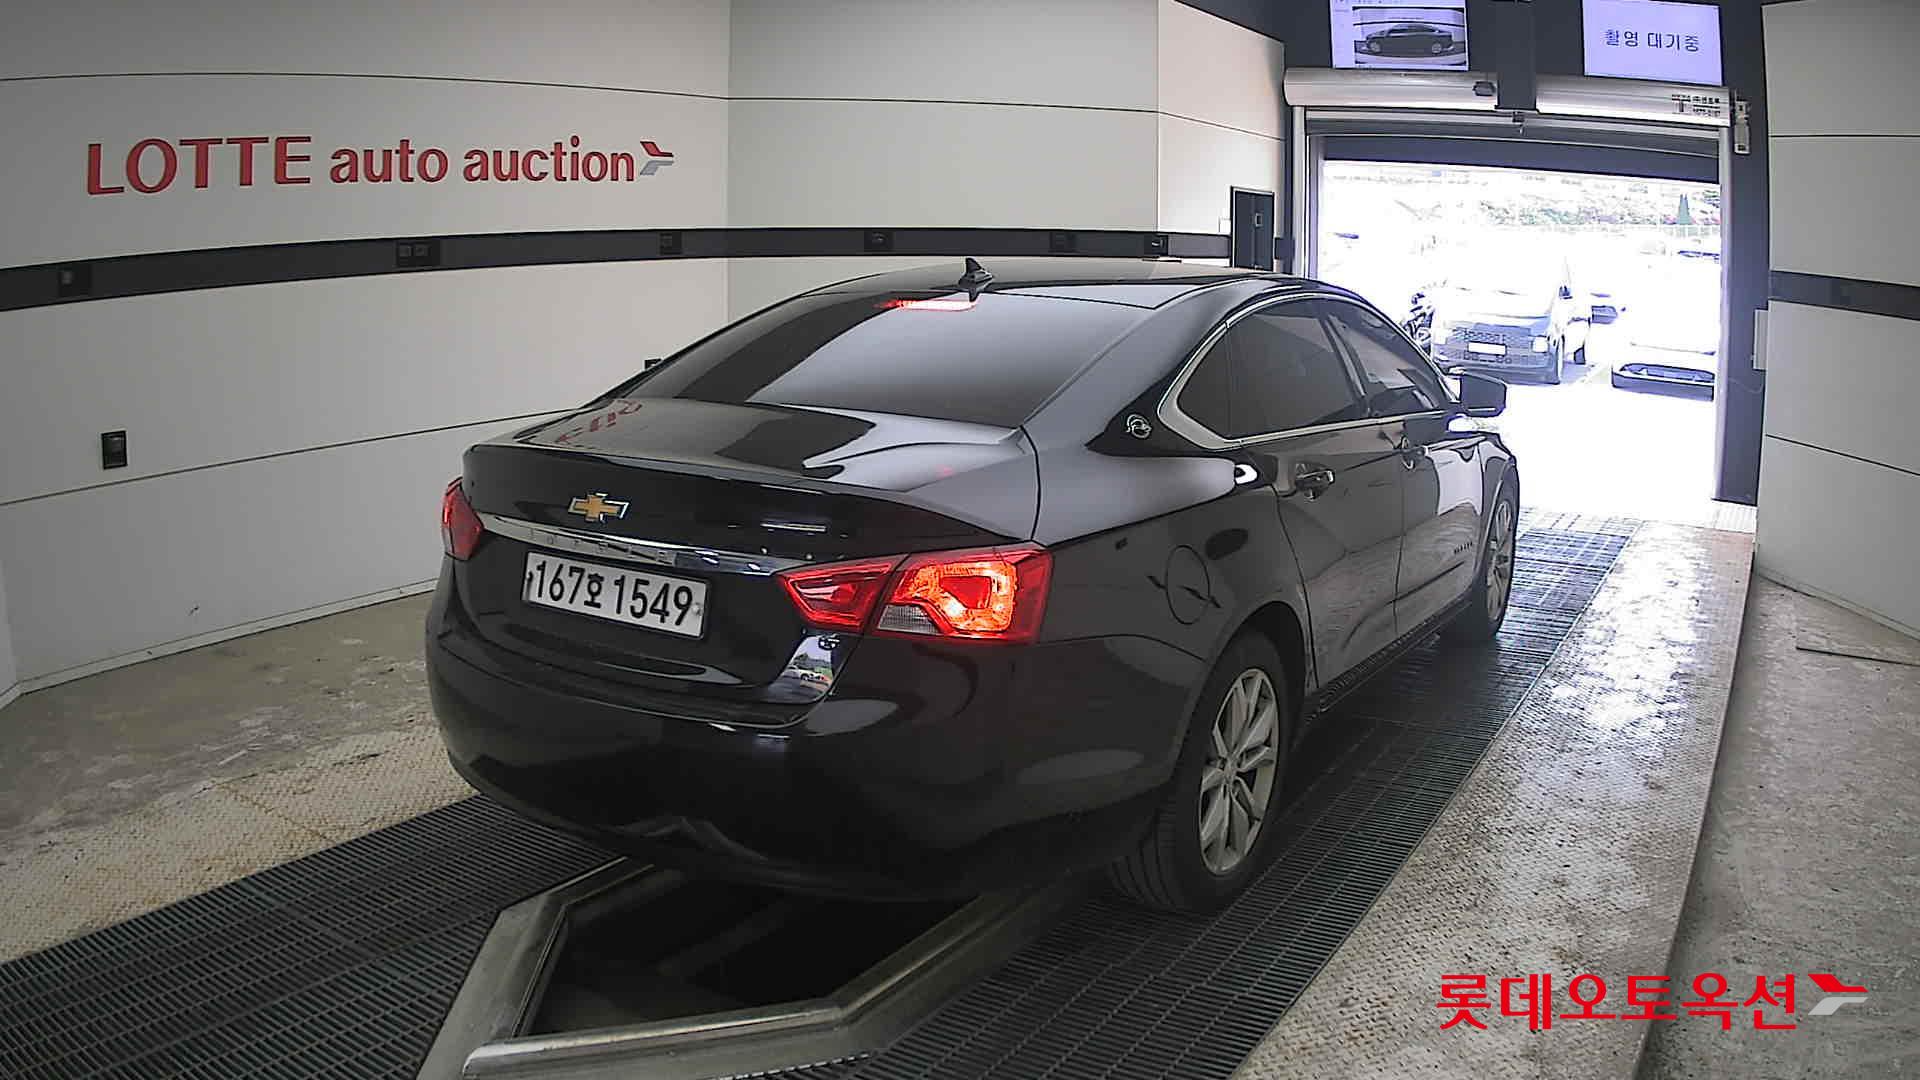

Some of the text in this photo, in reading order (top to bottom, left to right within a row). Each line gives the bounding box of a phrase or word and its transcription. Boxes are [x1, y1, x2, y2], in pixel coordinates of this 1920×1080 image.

[1605, 29, 1699, 52] 촬영 대기중
[87, 135, 634, 195] LOTTE auto auction
[536, 560, 694, 627] 167호 1549
